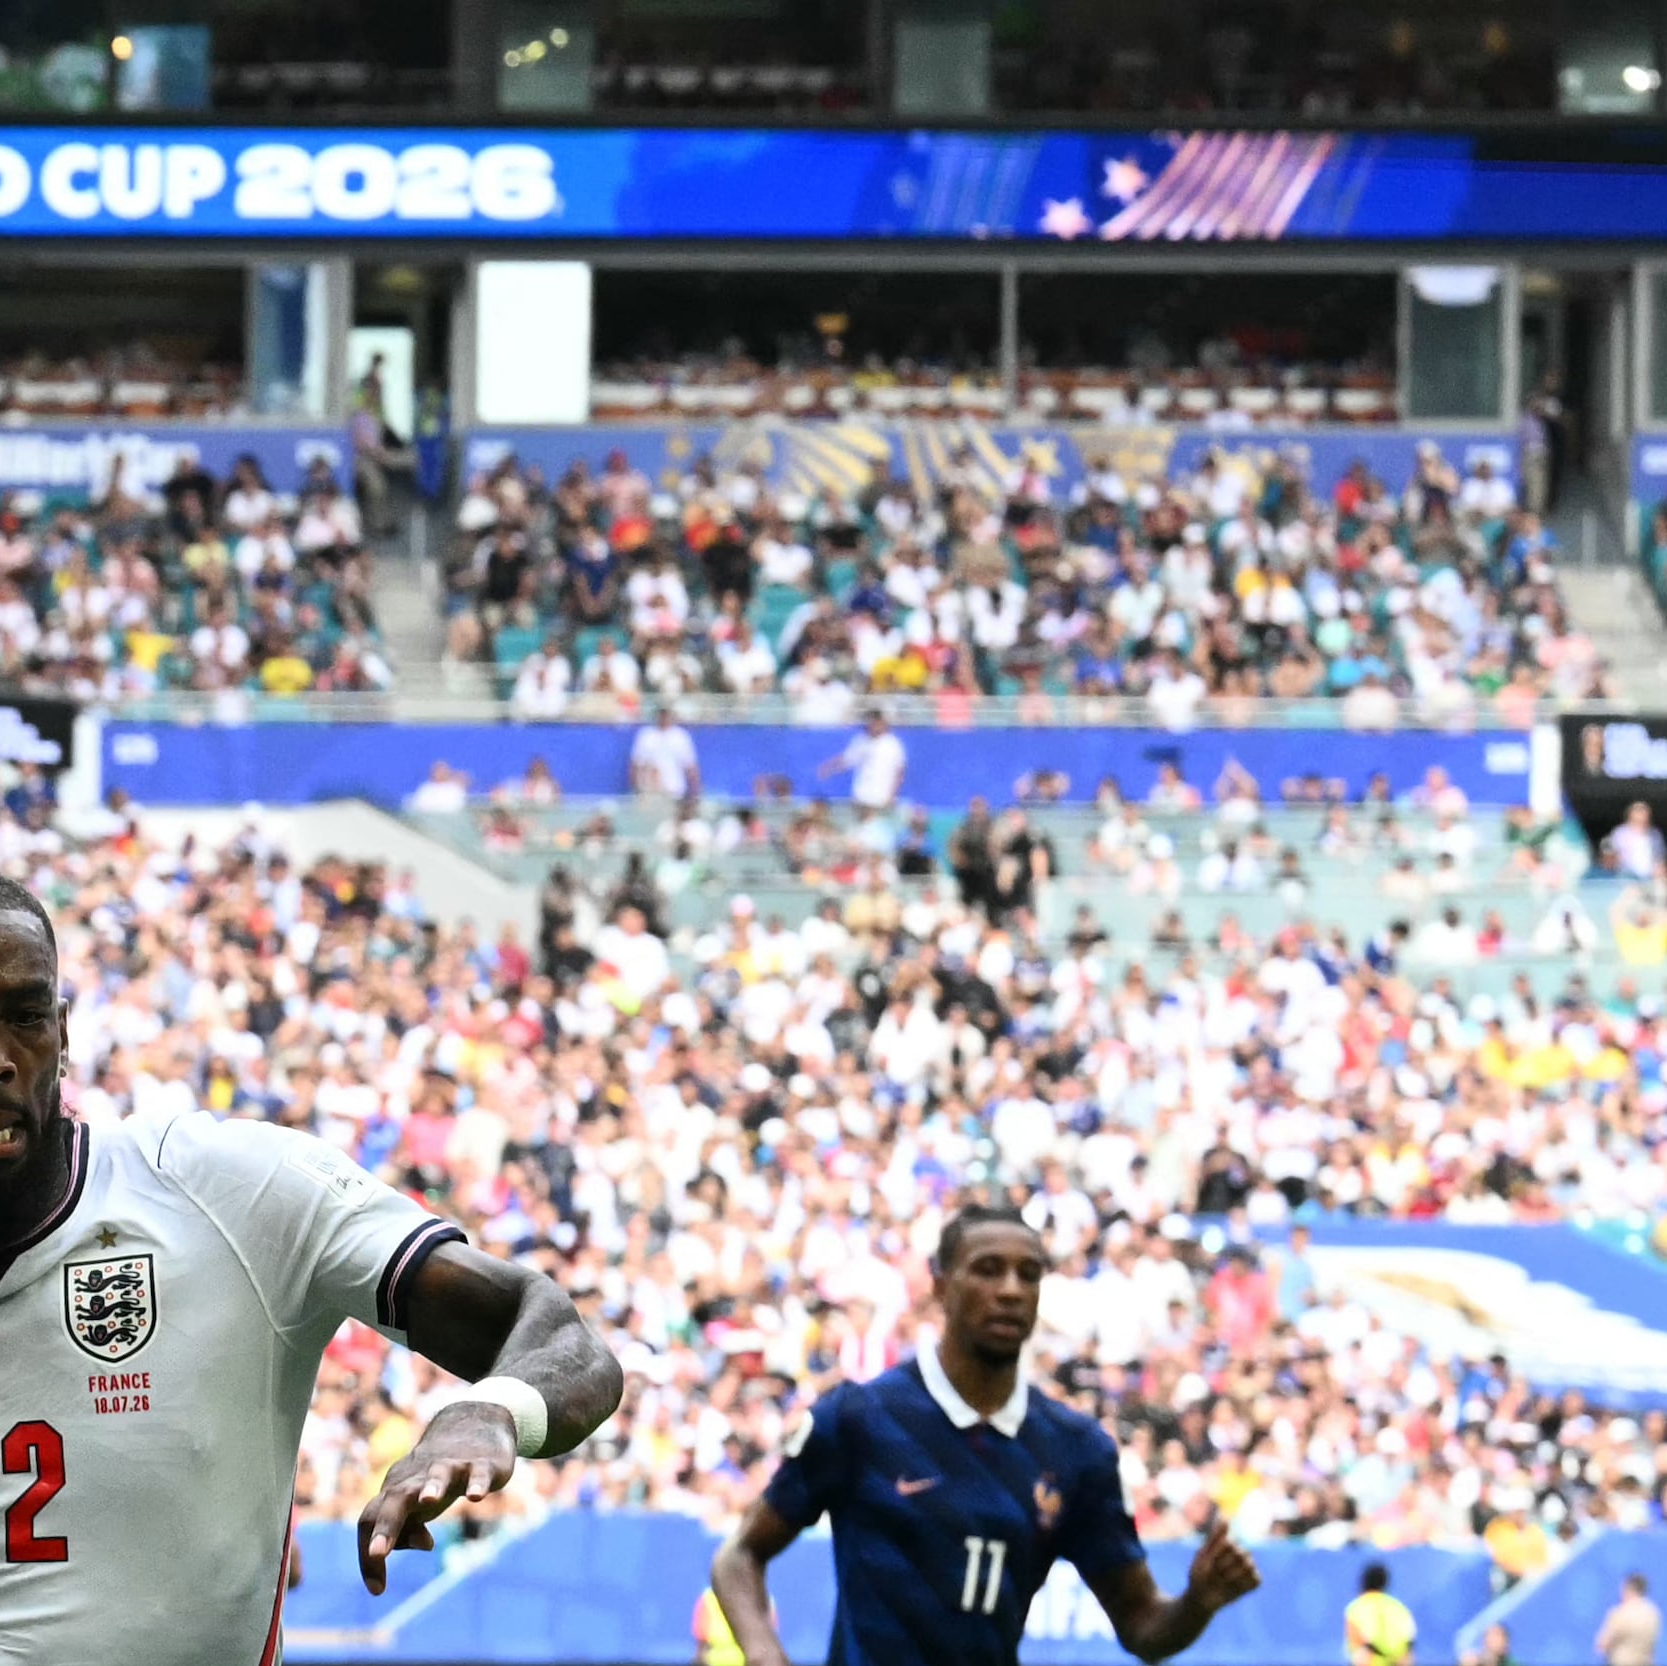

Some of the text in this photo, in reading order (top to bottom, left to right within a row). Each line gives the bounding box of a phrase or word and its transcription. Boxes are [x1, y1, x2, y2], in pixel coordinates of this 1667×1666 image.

[40, 142, 226, 219] CUP
[234, 142, 556, 220] 2026
[88, 1372, 151, 1392] FRANCE
[95, 1395, 150, 1414] 18.07.26
[960, 1535, 1007, 1615] 11
